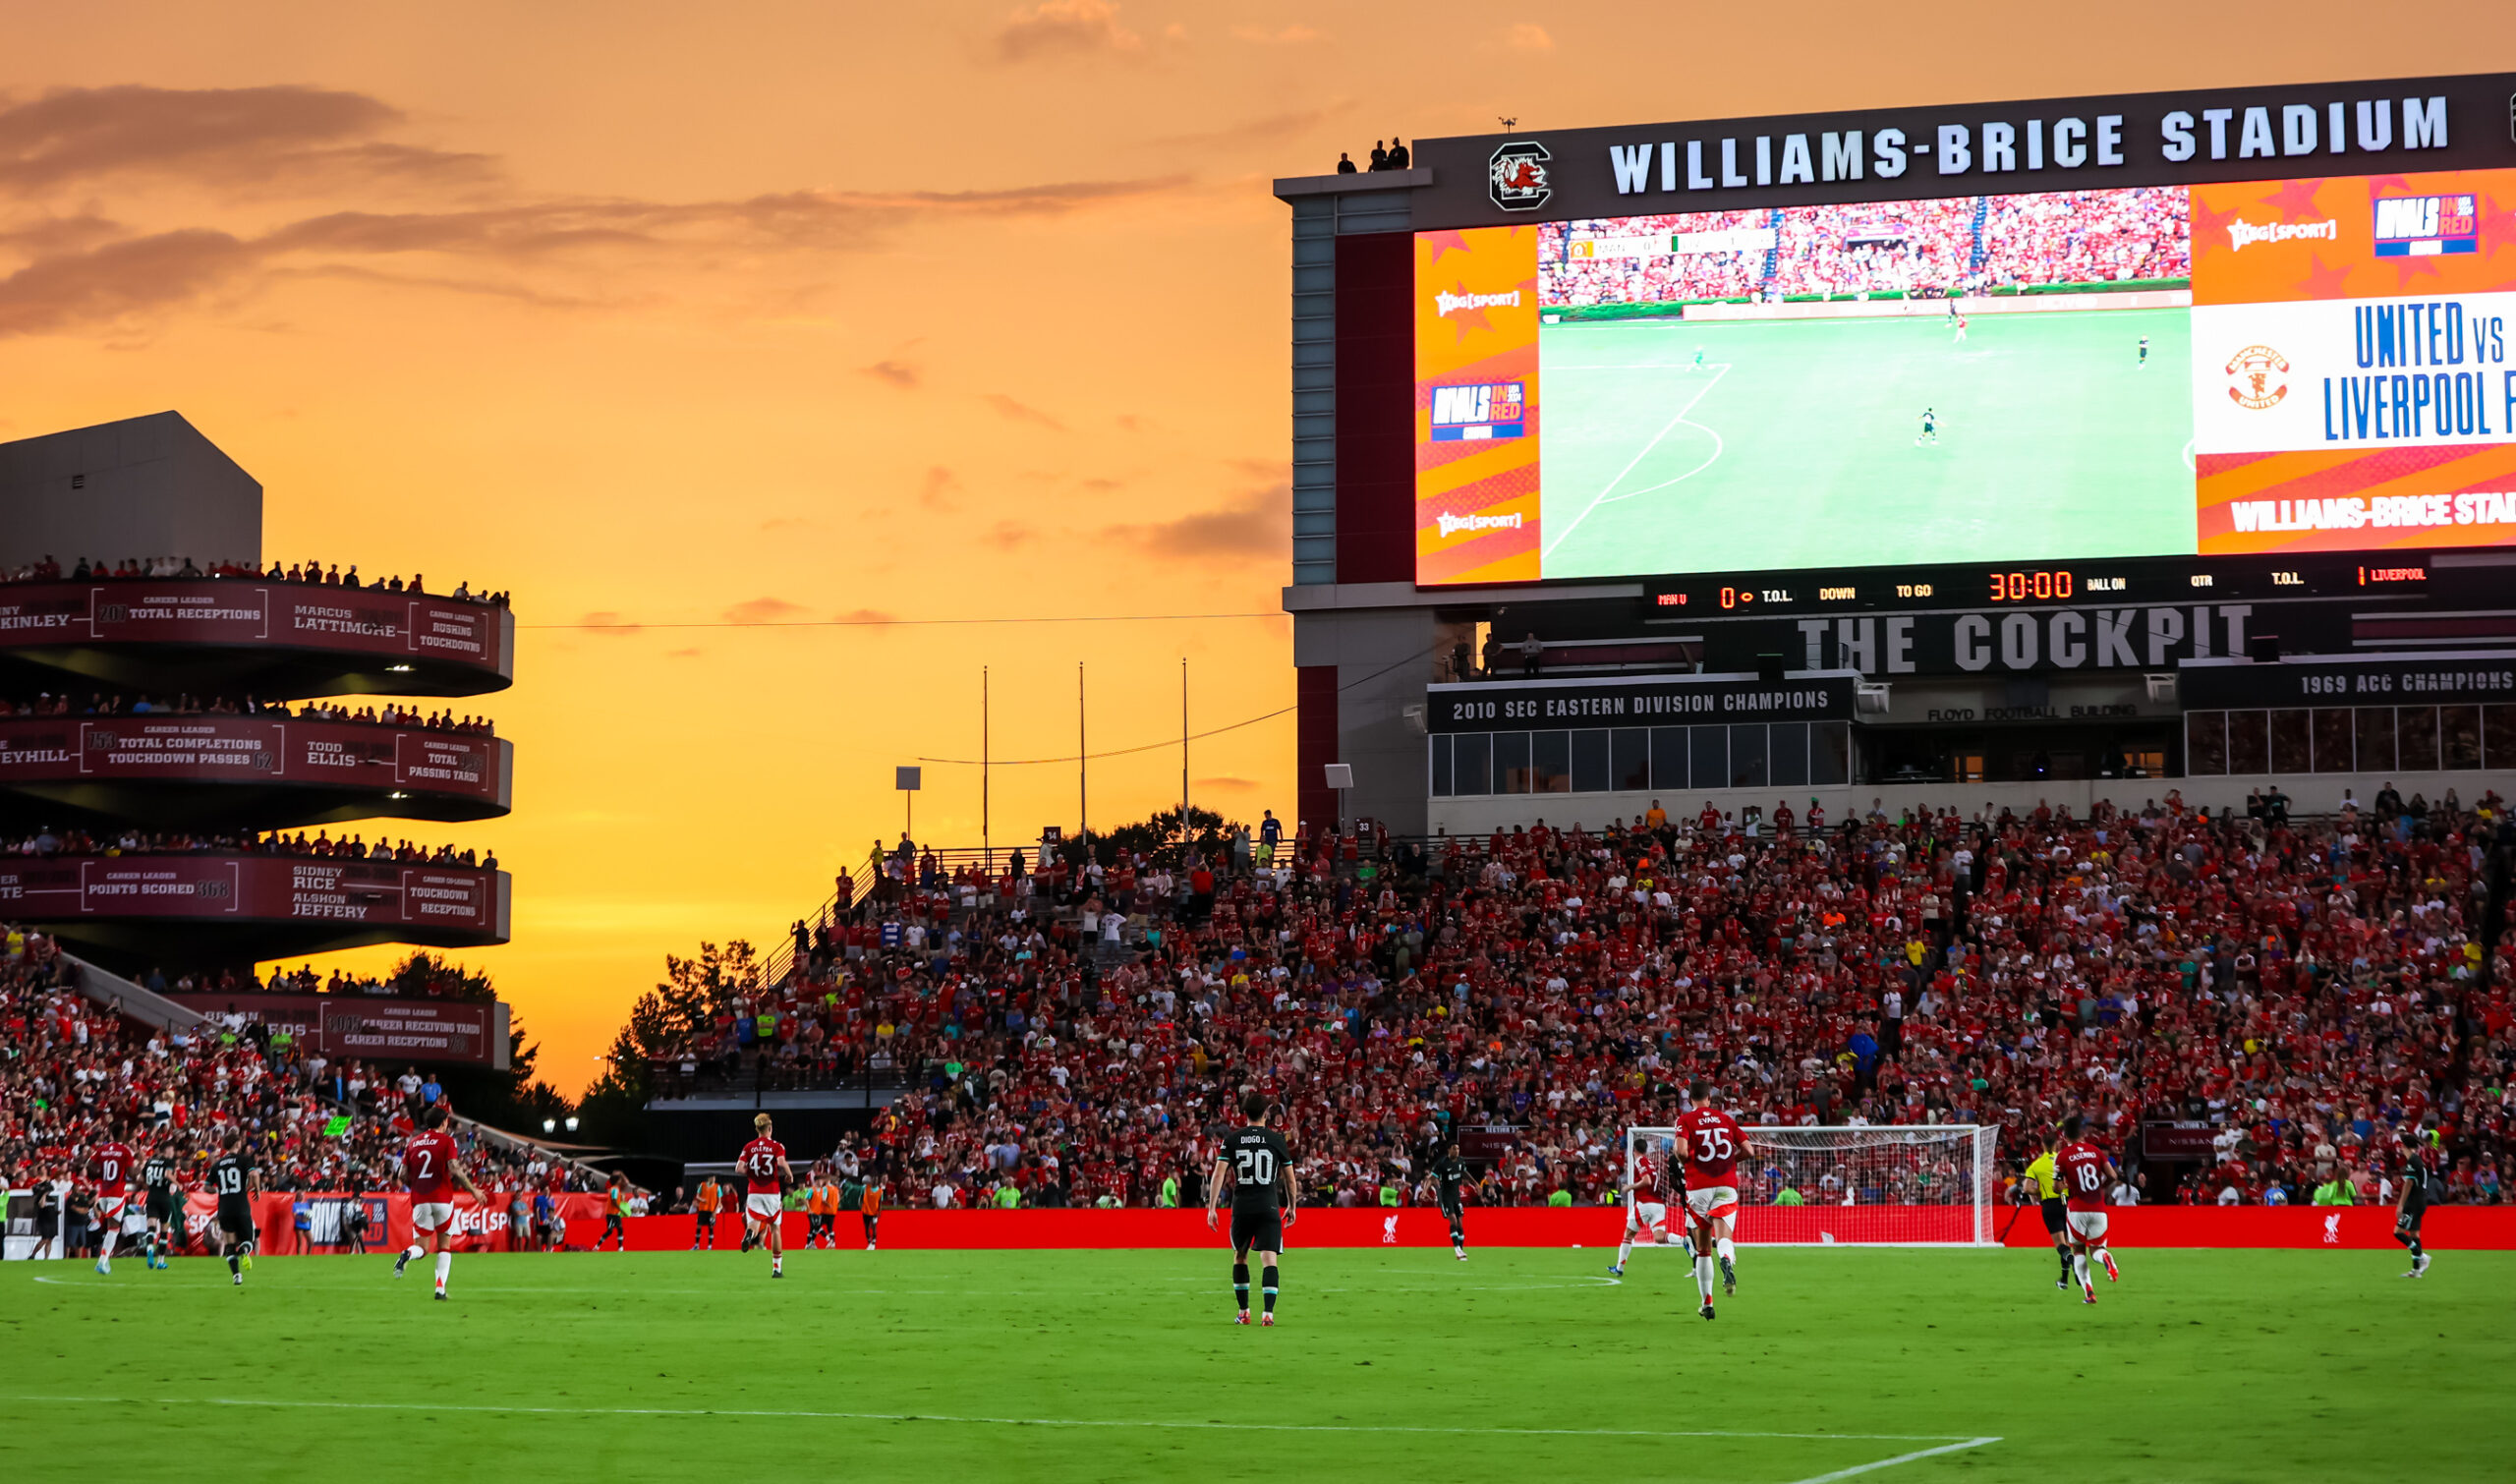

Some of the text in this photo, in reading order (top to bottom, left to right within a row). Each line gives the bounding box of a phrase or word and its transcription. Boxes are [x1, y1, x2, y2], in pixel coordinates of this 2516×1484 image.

[1609, 95, 2448, 196] WILLIAMS-BRICE STADIUM
[2439, 197, 2459, 216] IN
[2438, 215, 2474, 236] RED
[2355, 302, 2504, 369] UNITED VS
[1492, 384, 1509, 402] IN
[2239, 394, 2279, 410] UNITED
[2323, 371, 2492, 441] LIVERPOOL
[1490, 402, 1522, 422] RED
[2231, 493, 2453, 533] WILLIAMS-BRICE
[2190, 574, 2213, 588] QTR
[2271, 572, 2305, 586] T.O.L.
[2371, 568, 2427, 582] LIVERPOOL
[1896, 584, 1932, 598] TO GO
[1990, 571, 2073, 600] 30:00
[2087, 577, 2126, 592] BALL ON
[1657, 594, 1687, 605] MAN U
[1720, 587, 1735, 608] 0
[1761, 589, 1793, 602] T.O.L.
[1819, 587, 1856, 600] DOWN
[129, 607, 261, 621] TOTAL RECEPTIONS
[295, 604, 352, 619] MARCUS
[294, 616, 396, 638] LATTIMORE
[432, 622, 473, 637] RUSHING
[420, 635, 481, 654] TOUCHDOWNS
[1798, 604, 2253, 674] THE COCKPIT
[2302, 671, 2514, 694] 1969 ACC CHAMPIONS
[1453, 690, 1829, 720] 2010 SEC EASTERN DIVISION CHAMPIONS
[1927, 704, 2138, 721] FLOYD FOOTBALL BUILDING
[119, 737, 262, 751] TOTAL COMPLETIONS
[307, 741, 343, 754] TODD
[108, 753, 251, 766] TOUCHDOWN PASSES
[307, 752, 356, 768] ELLIS
[429, 753, 457, 766] TOTAL
[409, 766, 479, 783] PASSING YARDS
[1359, 823, 1370, 831] 33
[293, 865, 343, 879] SIDNEY
[88, 884, 195, 895] POINTS SCORED
[293, 876, 336, 890] RICE
[293, 892, 346, 904] ALSHON
[411, 886, 469, 901] TOUCHDOWN
[292, 902, 369, 920] JEFFERY
[421, 902, 476, 917] RECEPTIONS
[405, 1020, 455, 1034] RECEIVING
[456, 1023, 481, 1035] YARDS
[344, 1034, 385, 1046] CAREER
[387, 1036, 448, 1049] RECEPTIONS
[1697, 1115, 1722, 1126] EVANS
[1240, 1135, 1261, 1144] DIOGO
[1695, 1127, 1733, 1162] 35
[102, 1159, 119, 1181] 10
[418, 1149, 433, 1179] 2
[749, 1153, 774, 1177] 43
[1235, 1149, 1274, 1185] 20
[146, 1166, 164, 1187] 84
[218, 1167, 242, 1195] 19
[2076, 1163, 2100, 1193] 18
